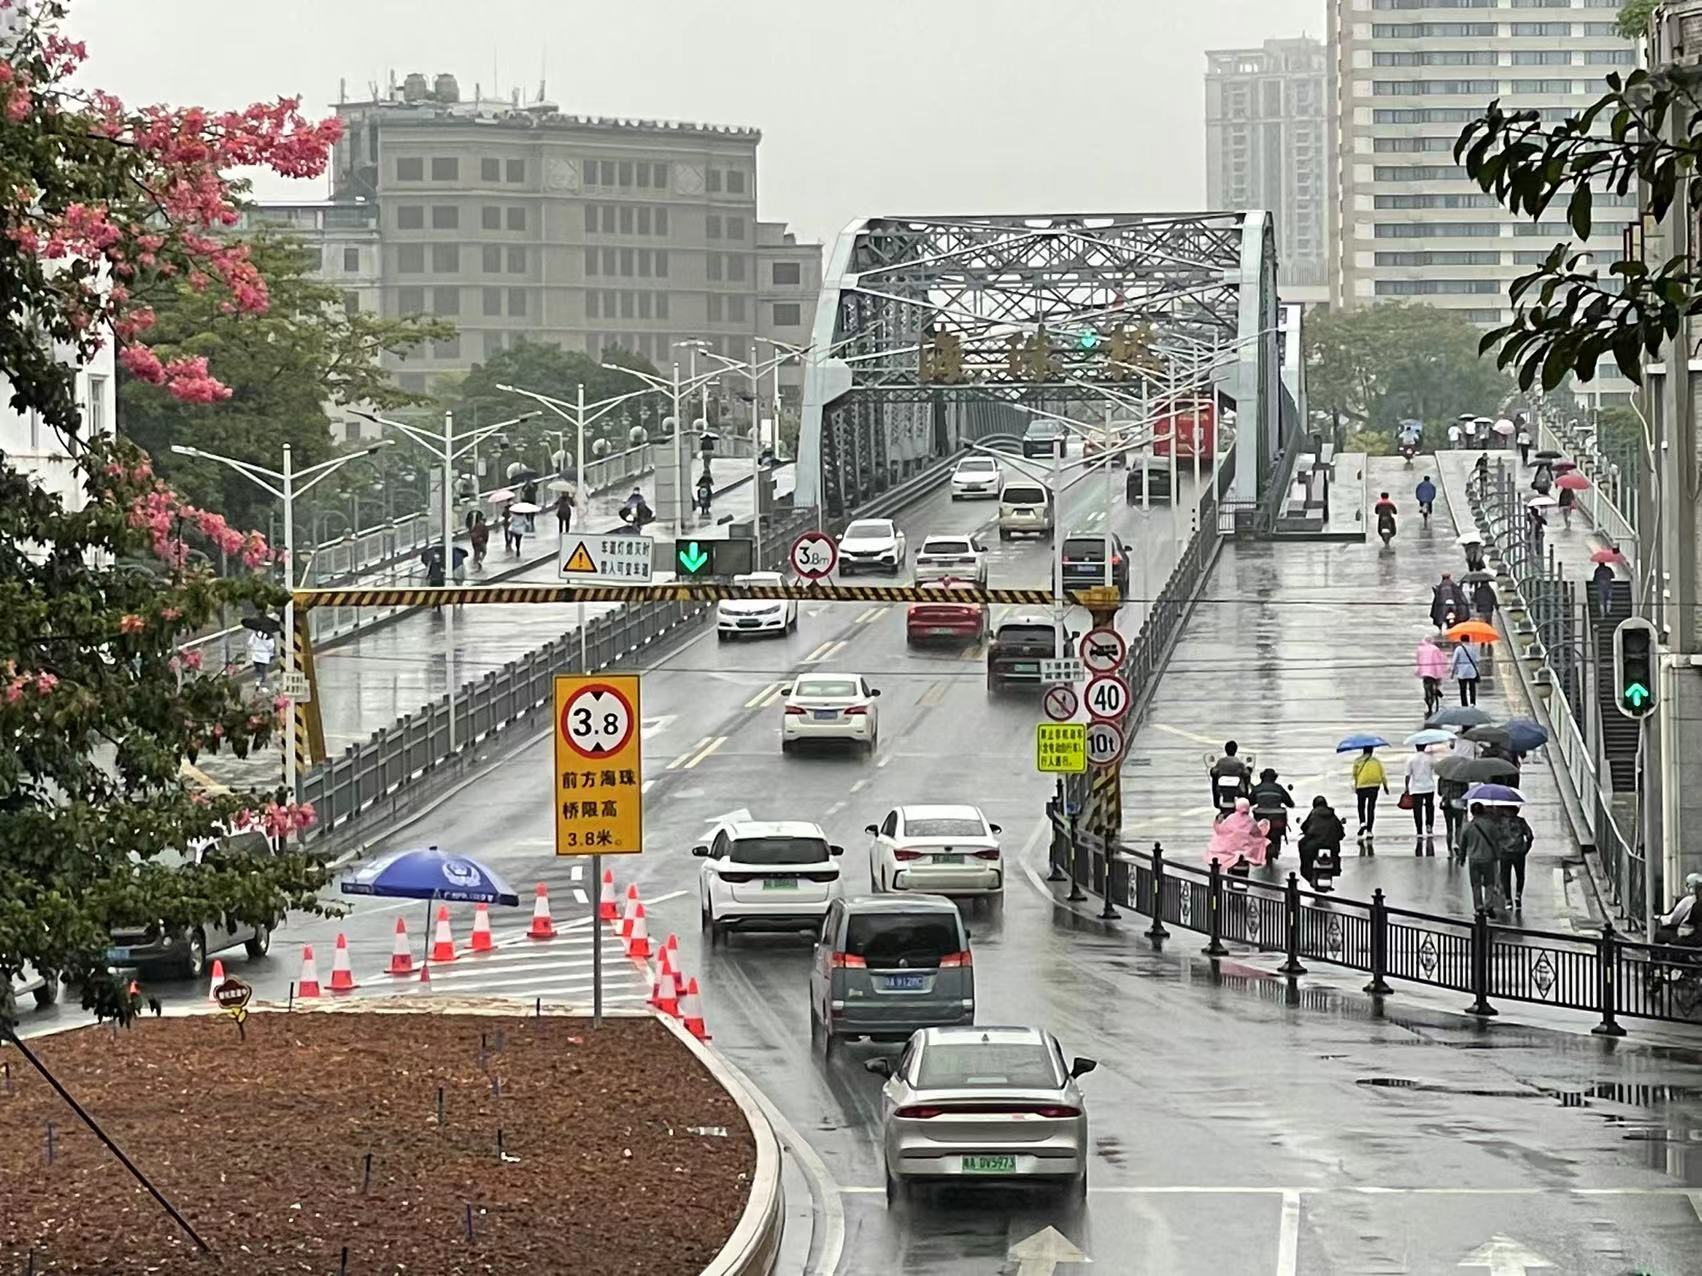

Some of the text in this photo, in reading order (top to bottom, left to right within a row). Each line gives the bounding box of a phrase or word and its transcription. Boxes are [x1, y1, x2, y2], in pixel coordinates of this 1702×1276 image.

[1094, 685, 1119, 711] 40
[573, 708, 619, 736] 3.8
[1087, 733, 1115, 754] 10t
[562, 768, 636, 789] 前方海珠
[563, 800, 617, 820] 桥限高
